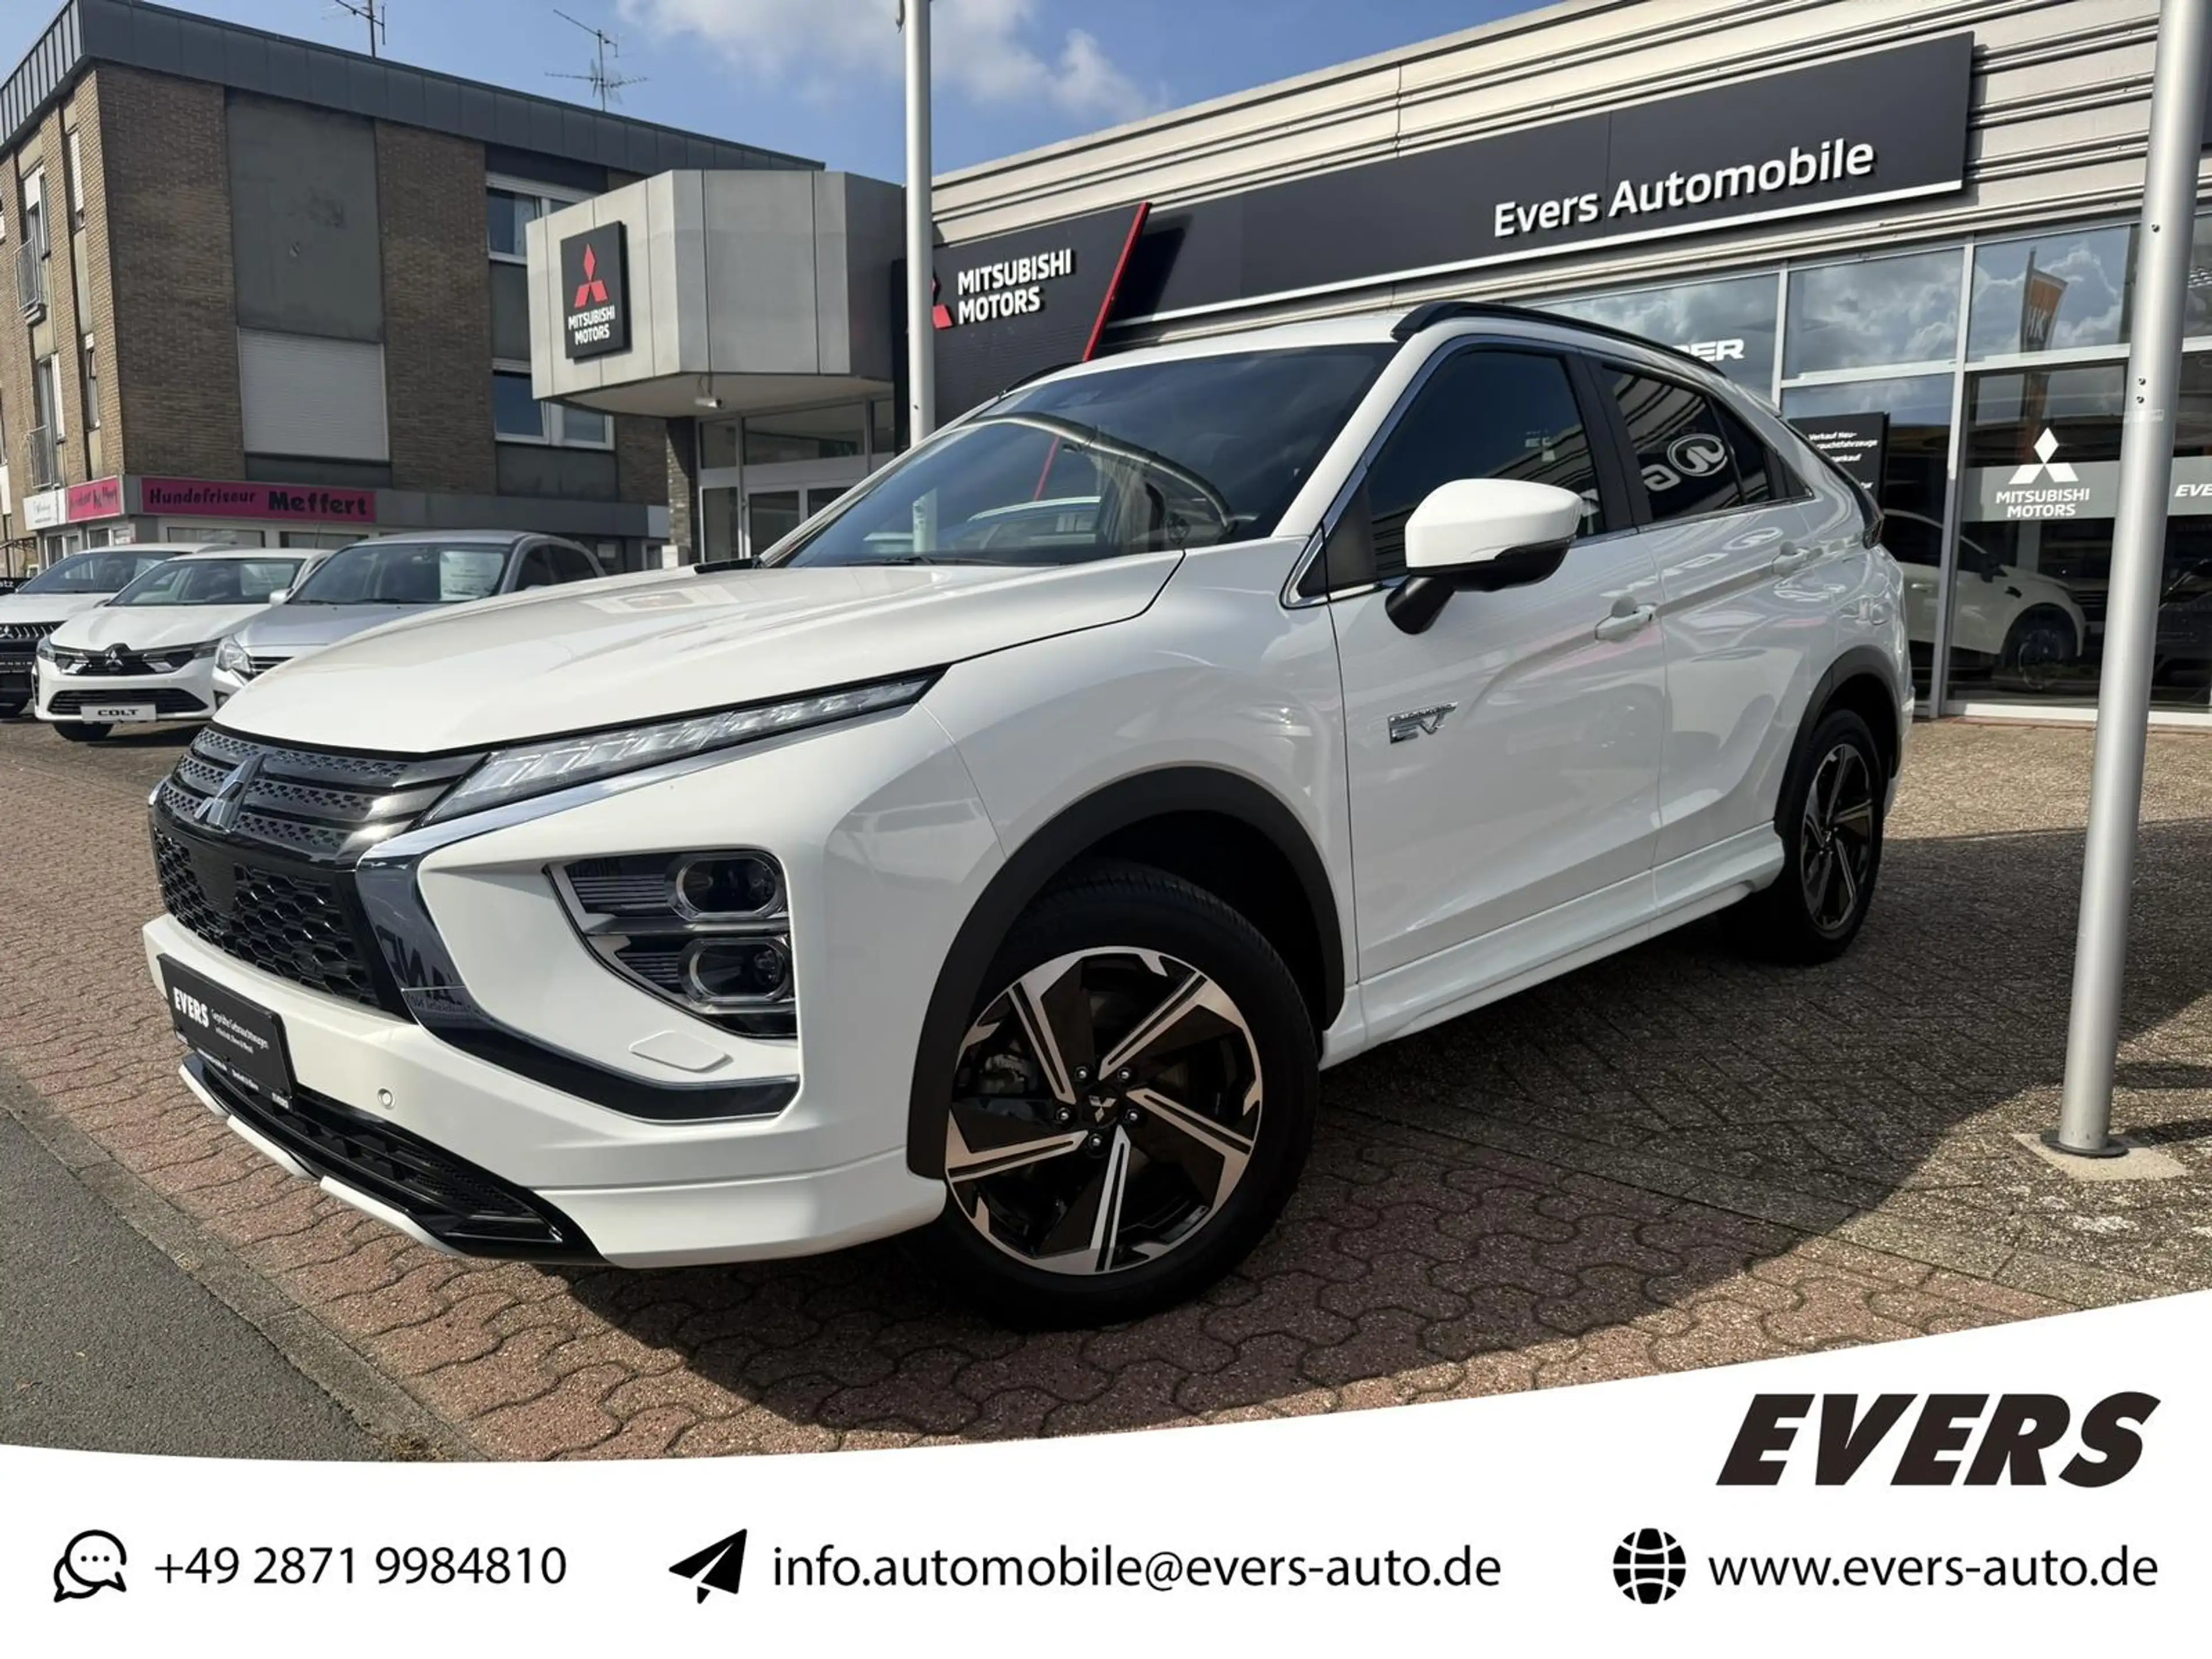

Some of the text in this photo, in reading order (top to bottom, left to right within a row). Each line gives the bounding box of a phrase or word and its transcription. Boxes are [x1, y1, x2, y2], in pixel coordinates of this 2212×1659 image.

[1495, 138, 1873, 237] Evers Automobile
[957, 248, 1071, 296] MITSUBISHI
[567, 304, 616, 331] MITSUBISHI
[958, 286, 1041, 325] MOTORS
[574, 324, 610, 346] MOTORS
[149, 487, 367, 516] Hundefriseur Meffert
[1995, 488, 2090, 505] MITSUBISHI
[2006, 503, 2077, 518] MOTORS
[173, 986, 210, 1028] EVERS
